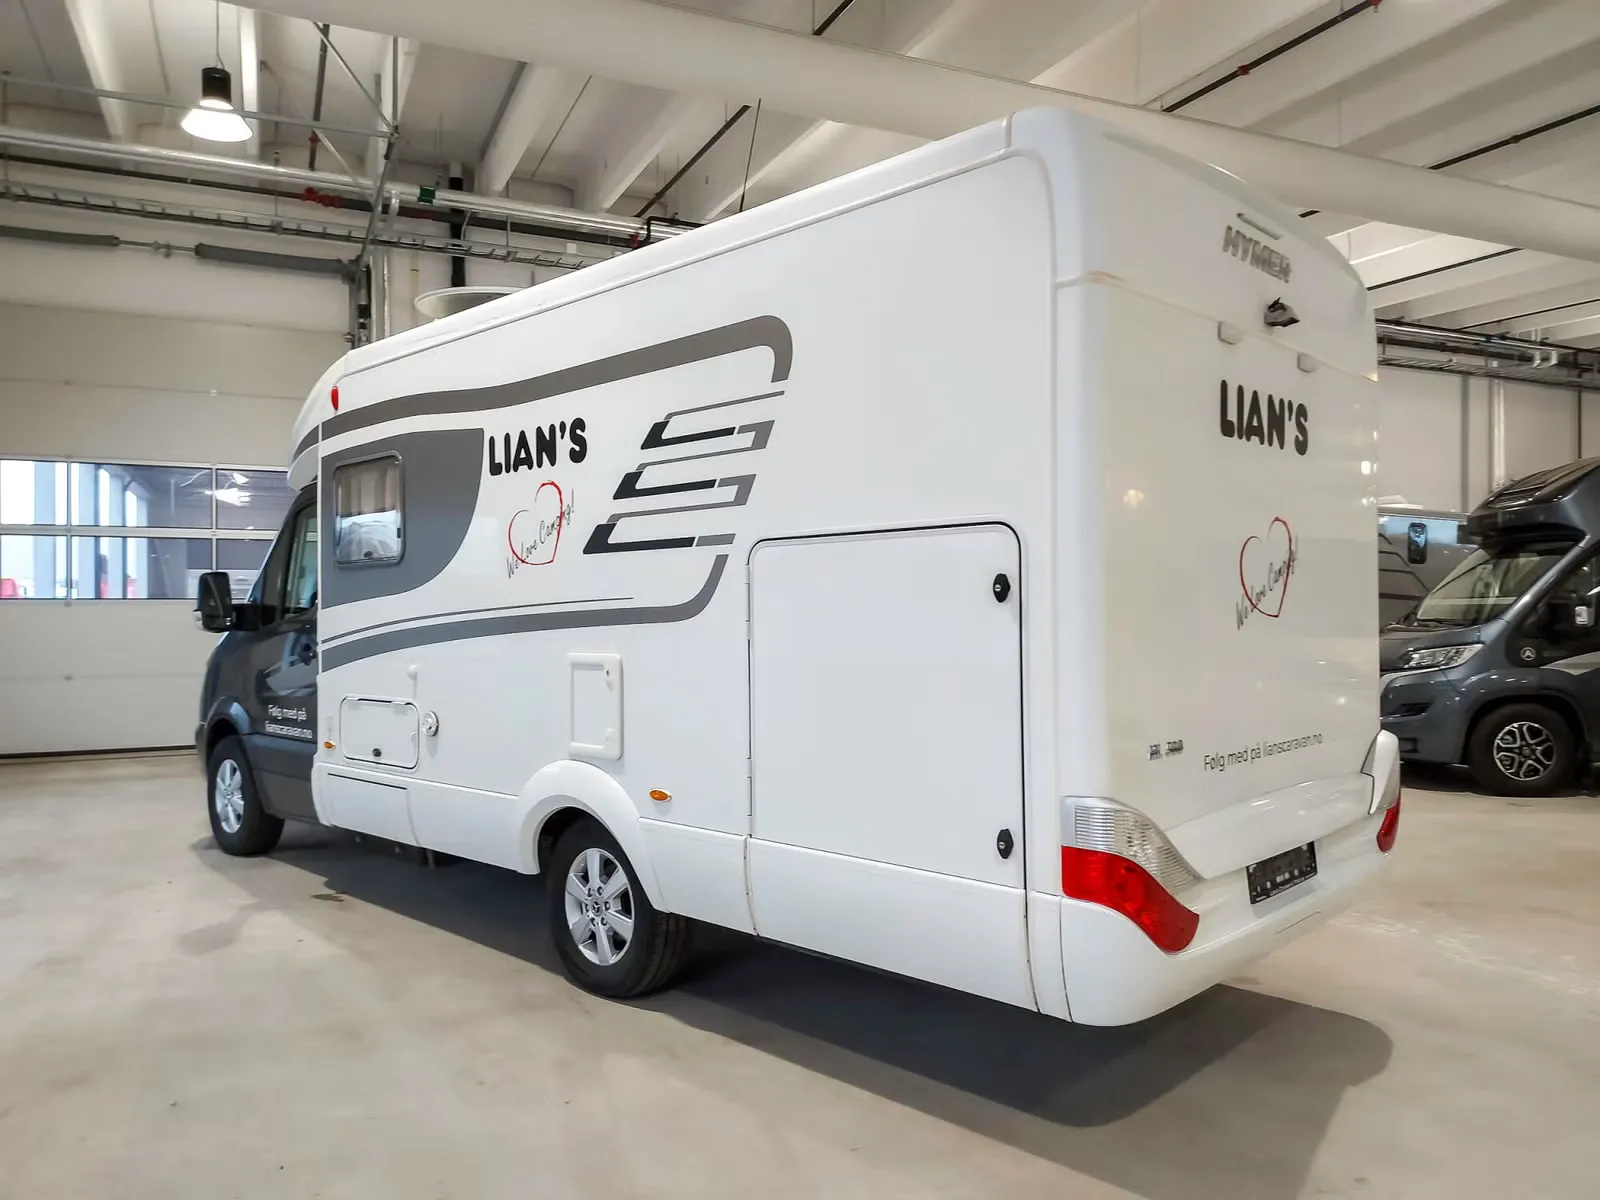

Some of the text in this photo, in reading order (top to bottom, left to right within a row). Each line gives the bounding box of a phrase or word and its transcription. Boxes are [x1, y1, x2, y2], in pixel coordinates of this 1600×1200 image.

[1222, 224, 1292, 284] HYMER
[488, 417, 588, 477] LIAN'S
[1220, 379, 1309, 456] LIAN'S
[282, 707, 297, 719] med
[297, 707, 307, 722] på
[1203, 752, 1225, 772] Følg
[1227, 745, 1249, 766] med
[1250, 741, 1262, 765] på
